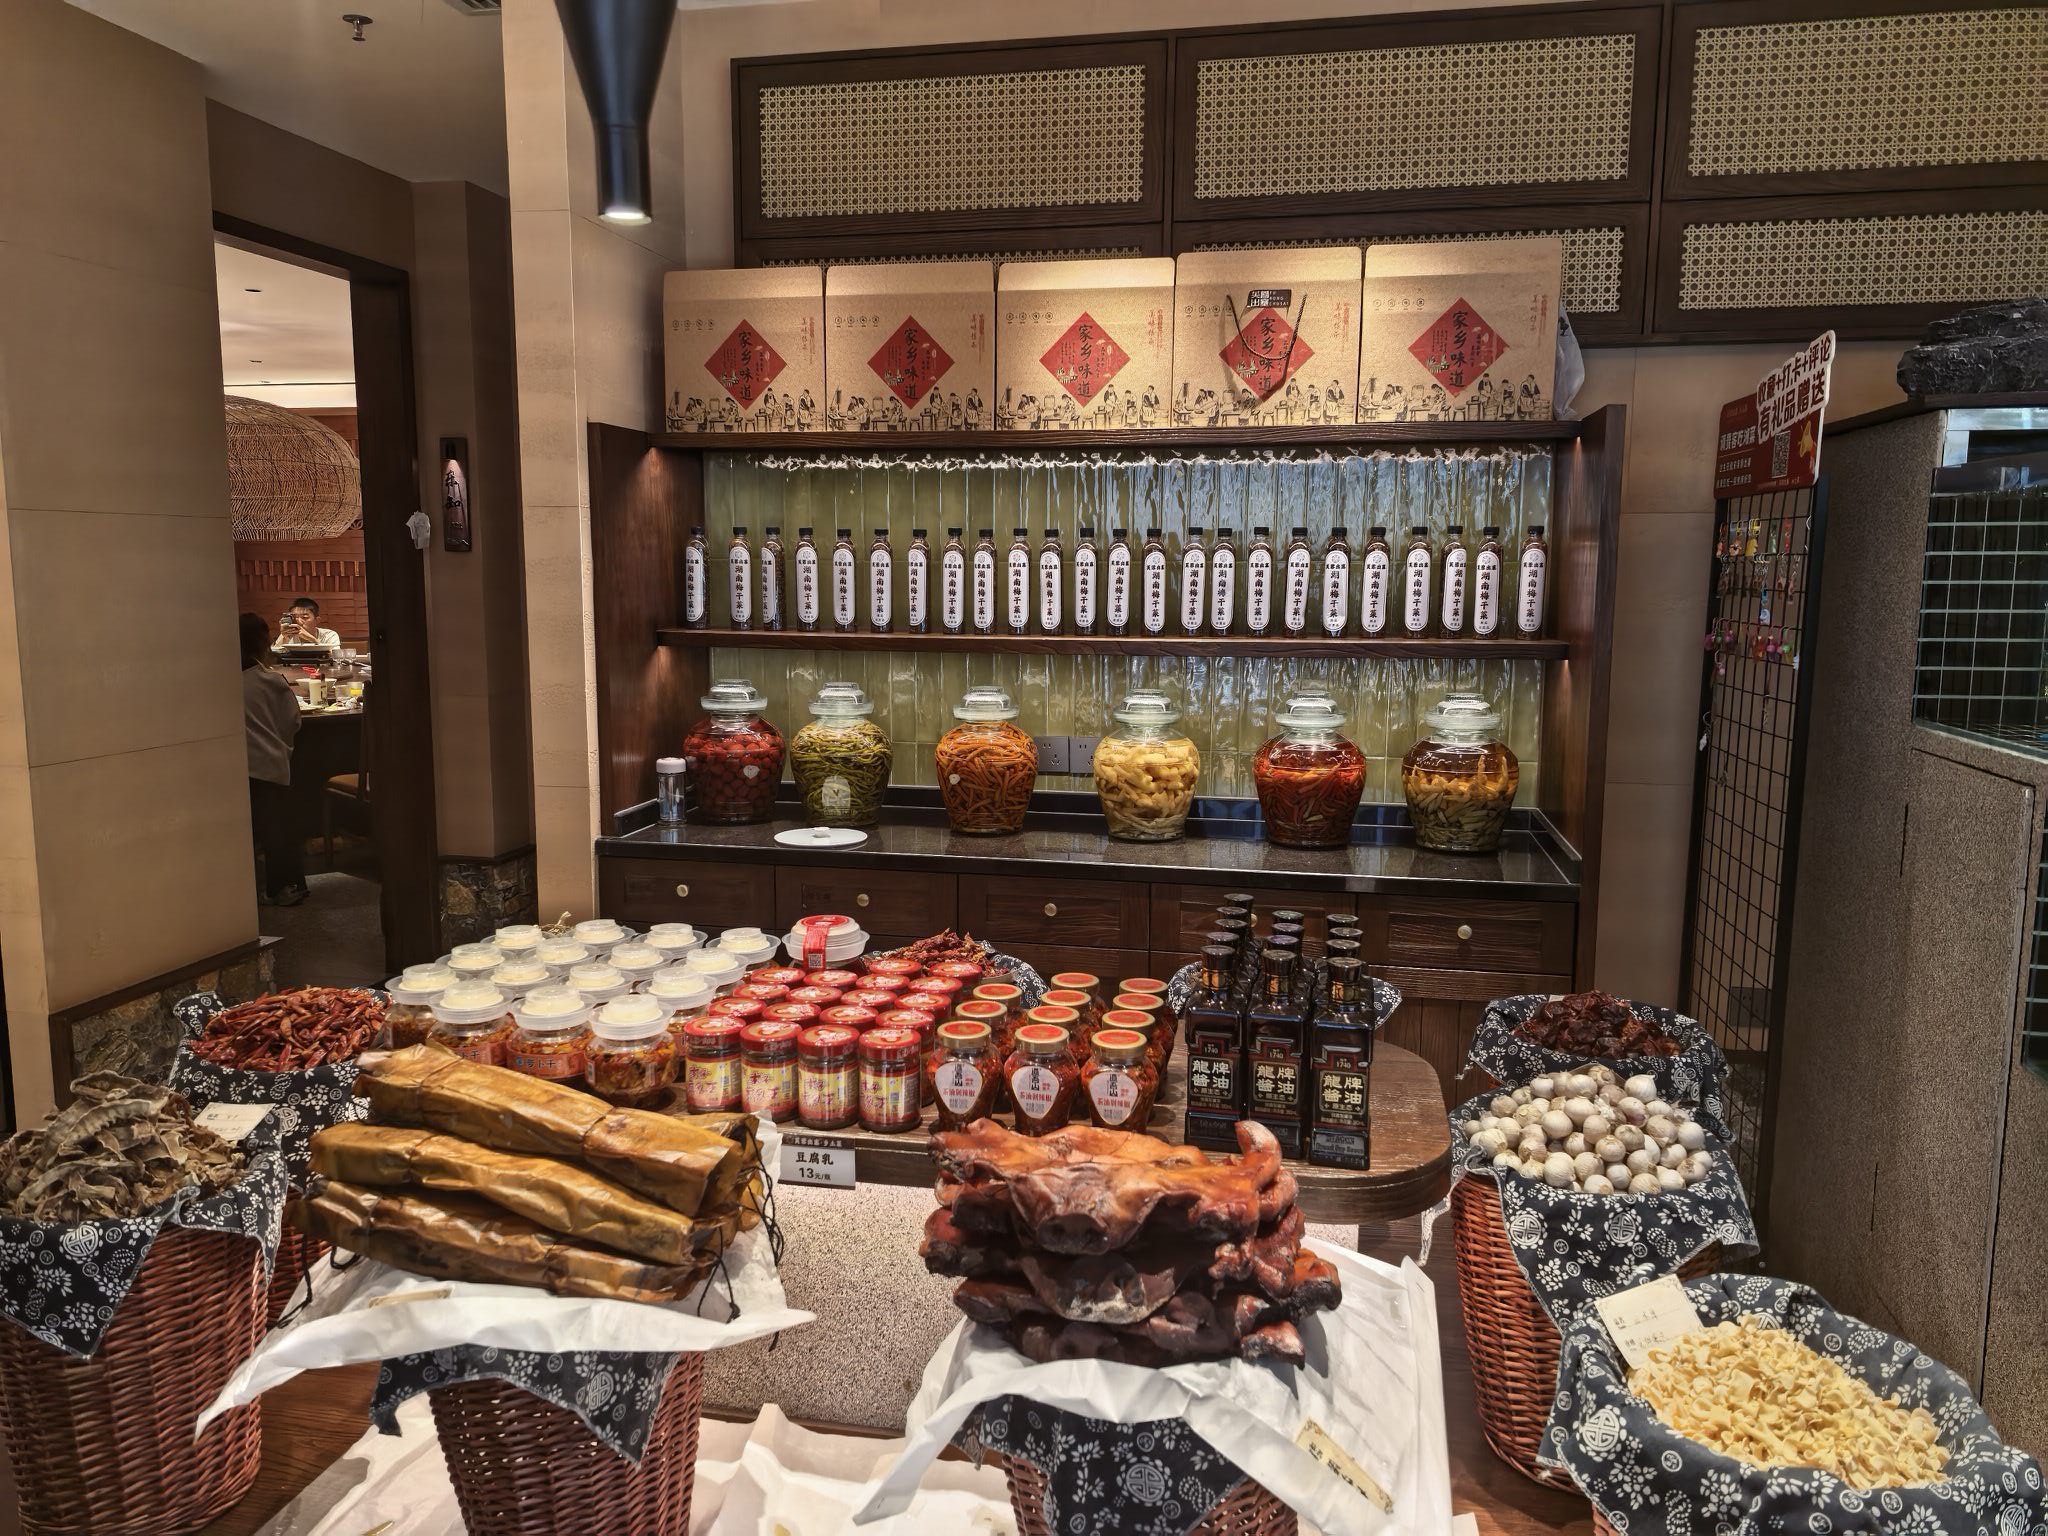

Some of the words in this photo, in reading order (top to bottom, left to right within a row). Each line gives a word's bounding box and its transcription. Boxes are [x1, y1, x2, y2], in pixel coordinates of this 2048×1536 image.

[738, 331, 752, 400] 家乡味道
[904, 328, 920, 400] 家乡味道
[1078, 324, 1093, 398] 家乡味道
[1259, 317, 1276, 391] 家乡味道
[1450, 311, 1468, 388] 家乡味道
[1760, 368, 1825, 439] 有礼品赠送
[804, 566, 812, 610] 湖南梅干菜
[876, 569, 884, 613] 湖南梅干菜
[910, 569, 918, 612] 湖南梅干菜
[978, 570, 986, 614] 湖南梅干菜
[1013, 569, 1021, 614] 湖南梅干菜
[1080, 569, 1088, 614] 湖南梅干菜
[1114, 568, 1124, 613] 湖南梅干菜
[1152, 572, 1160, 617] 湖南梅干菜
[1189, 570, 1198, 616] 湖南梅干菜
[1218, 570, 1226, 616] 湖南梅干菜
[1254, 570, 1263, 616] 湖南梅干菜
[1293, 570, 1304, 616] 湖南梅干菜
[1330, 571, 1339, 618] 湖南梅干菜
[1370, 572, 1380, 618] 湖南梅干菜
[1412, 569, 1423, 617] 湖南梅干菜
[1452, 569, 1462, 617] 湖南梅干菜
[1480, 572, 1490, 620] 湖南梅干菜
[1526, 570, 1538, 617] 湖南梅干菜
[1192, 1060, 1230, 1075] 龍牌
[1257, 1065, 1296, 1080] 龍牌
[1323, 1075, 1363, 1089] 龍牌
[796, 1152, 834, 1166] 豆腐乳
